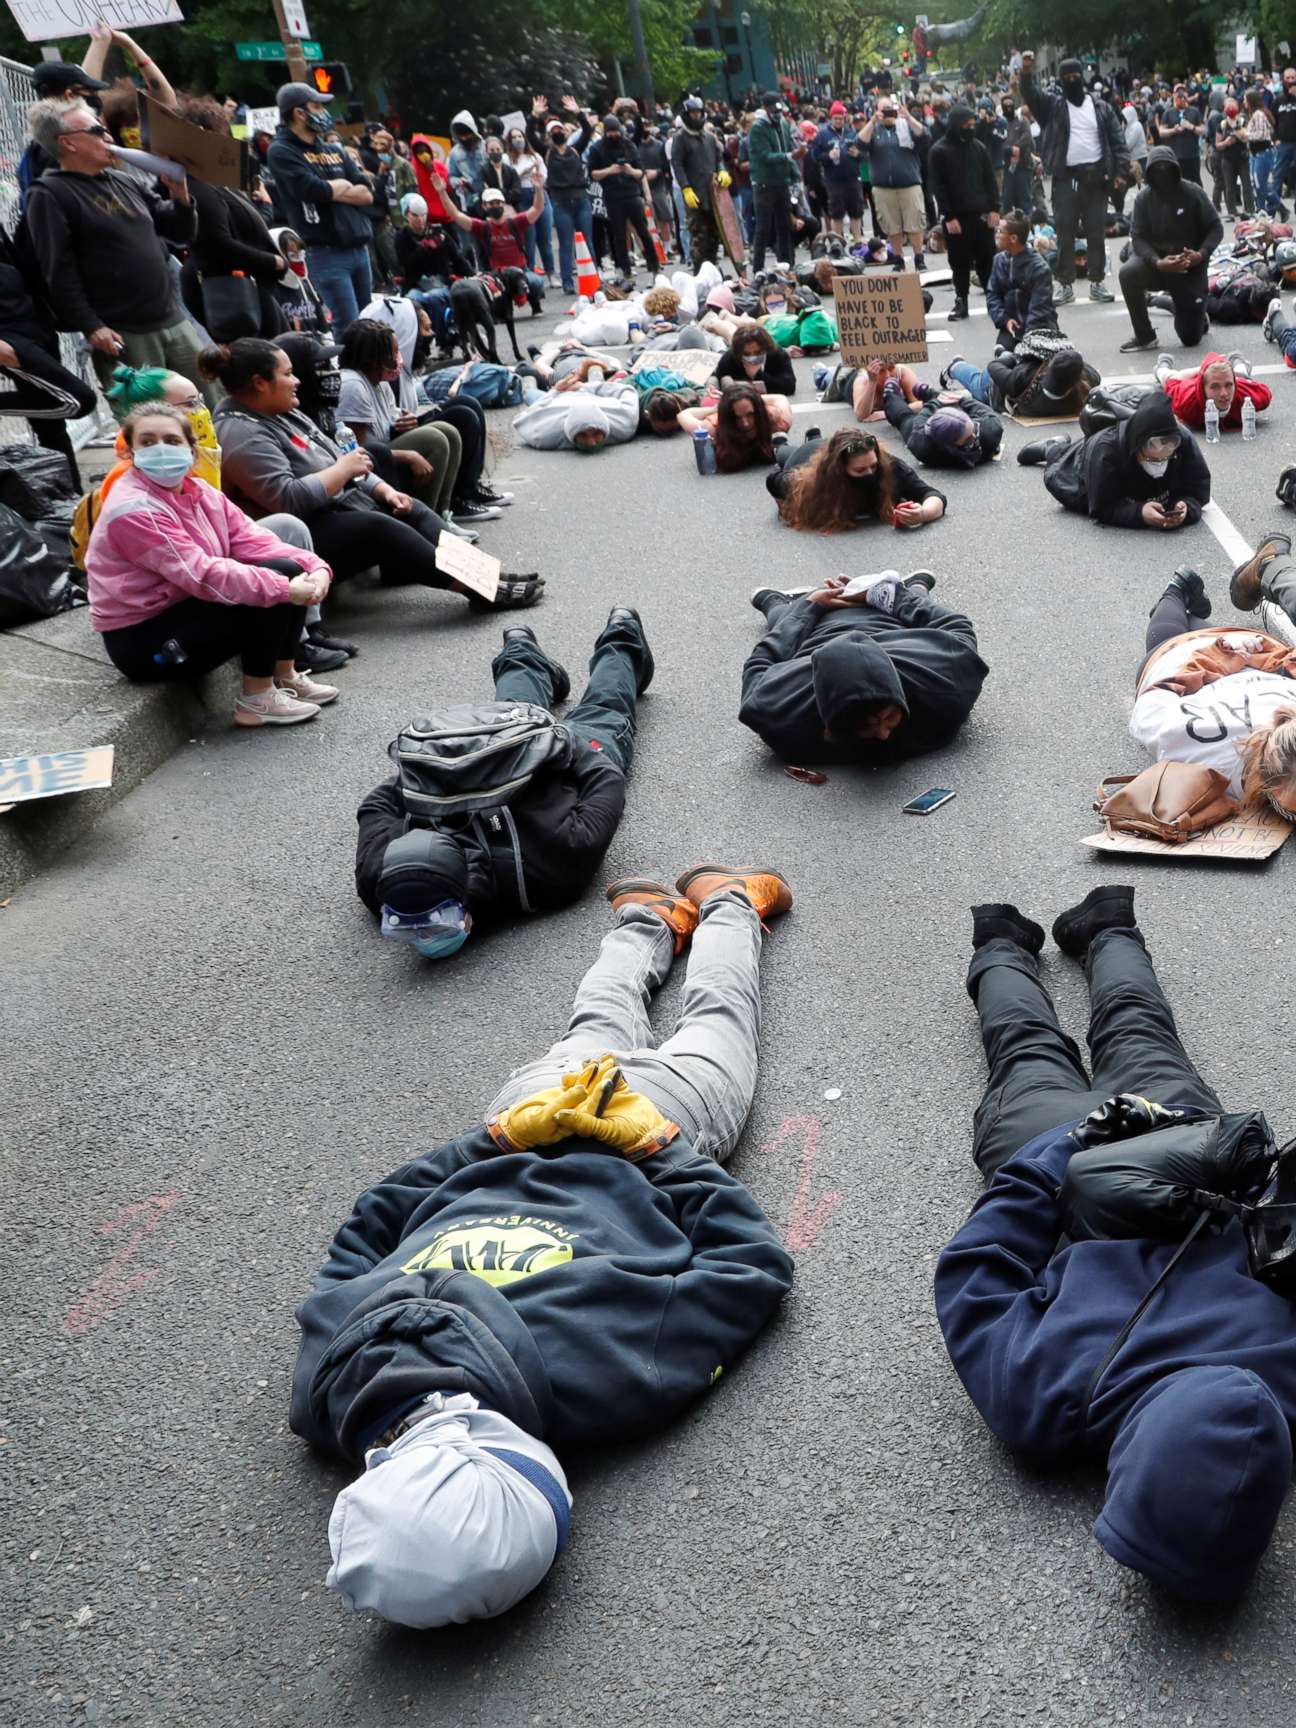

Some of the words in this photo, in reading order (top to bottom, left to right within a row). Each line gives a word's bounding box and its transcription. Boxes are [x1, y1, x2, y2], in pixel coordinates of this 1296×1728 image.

[841, 279, 864, 296] YOU
[867, 277, 899, 293] DONT
[837, 300, 868, 314] HAVE
[871, 301, 885, 313] TO
[889, 299, 904, 313] BE
[841, 316, 878, 331] BLACK
[885, 316, 900, 329] TO
[841, 332, 867, 346] FEEL
[872, 328, 928, 345] OUTRAGED
